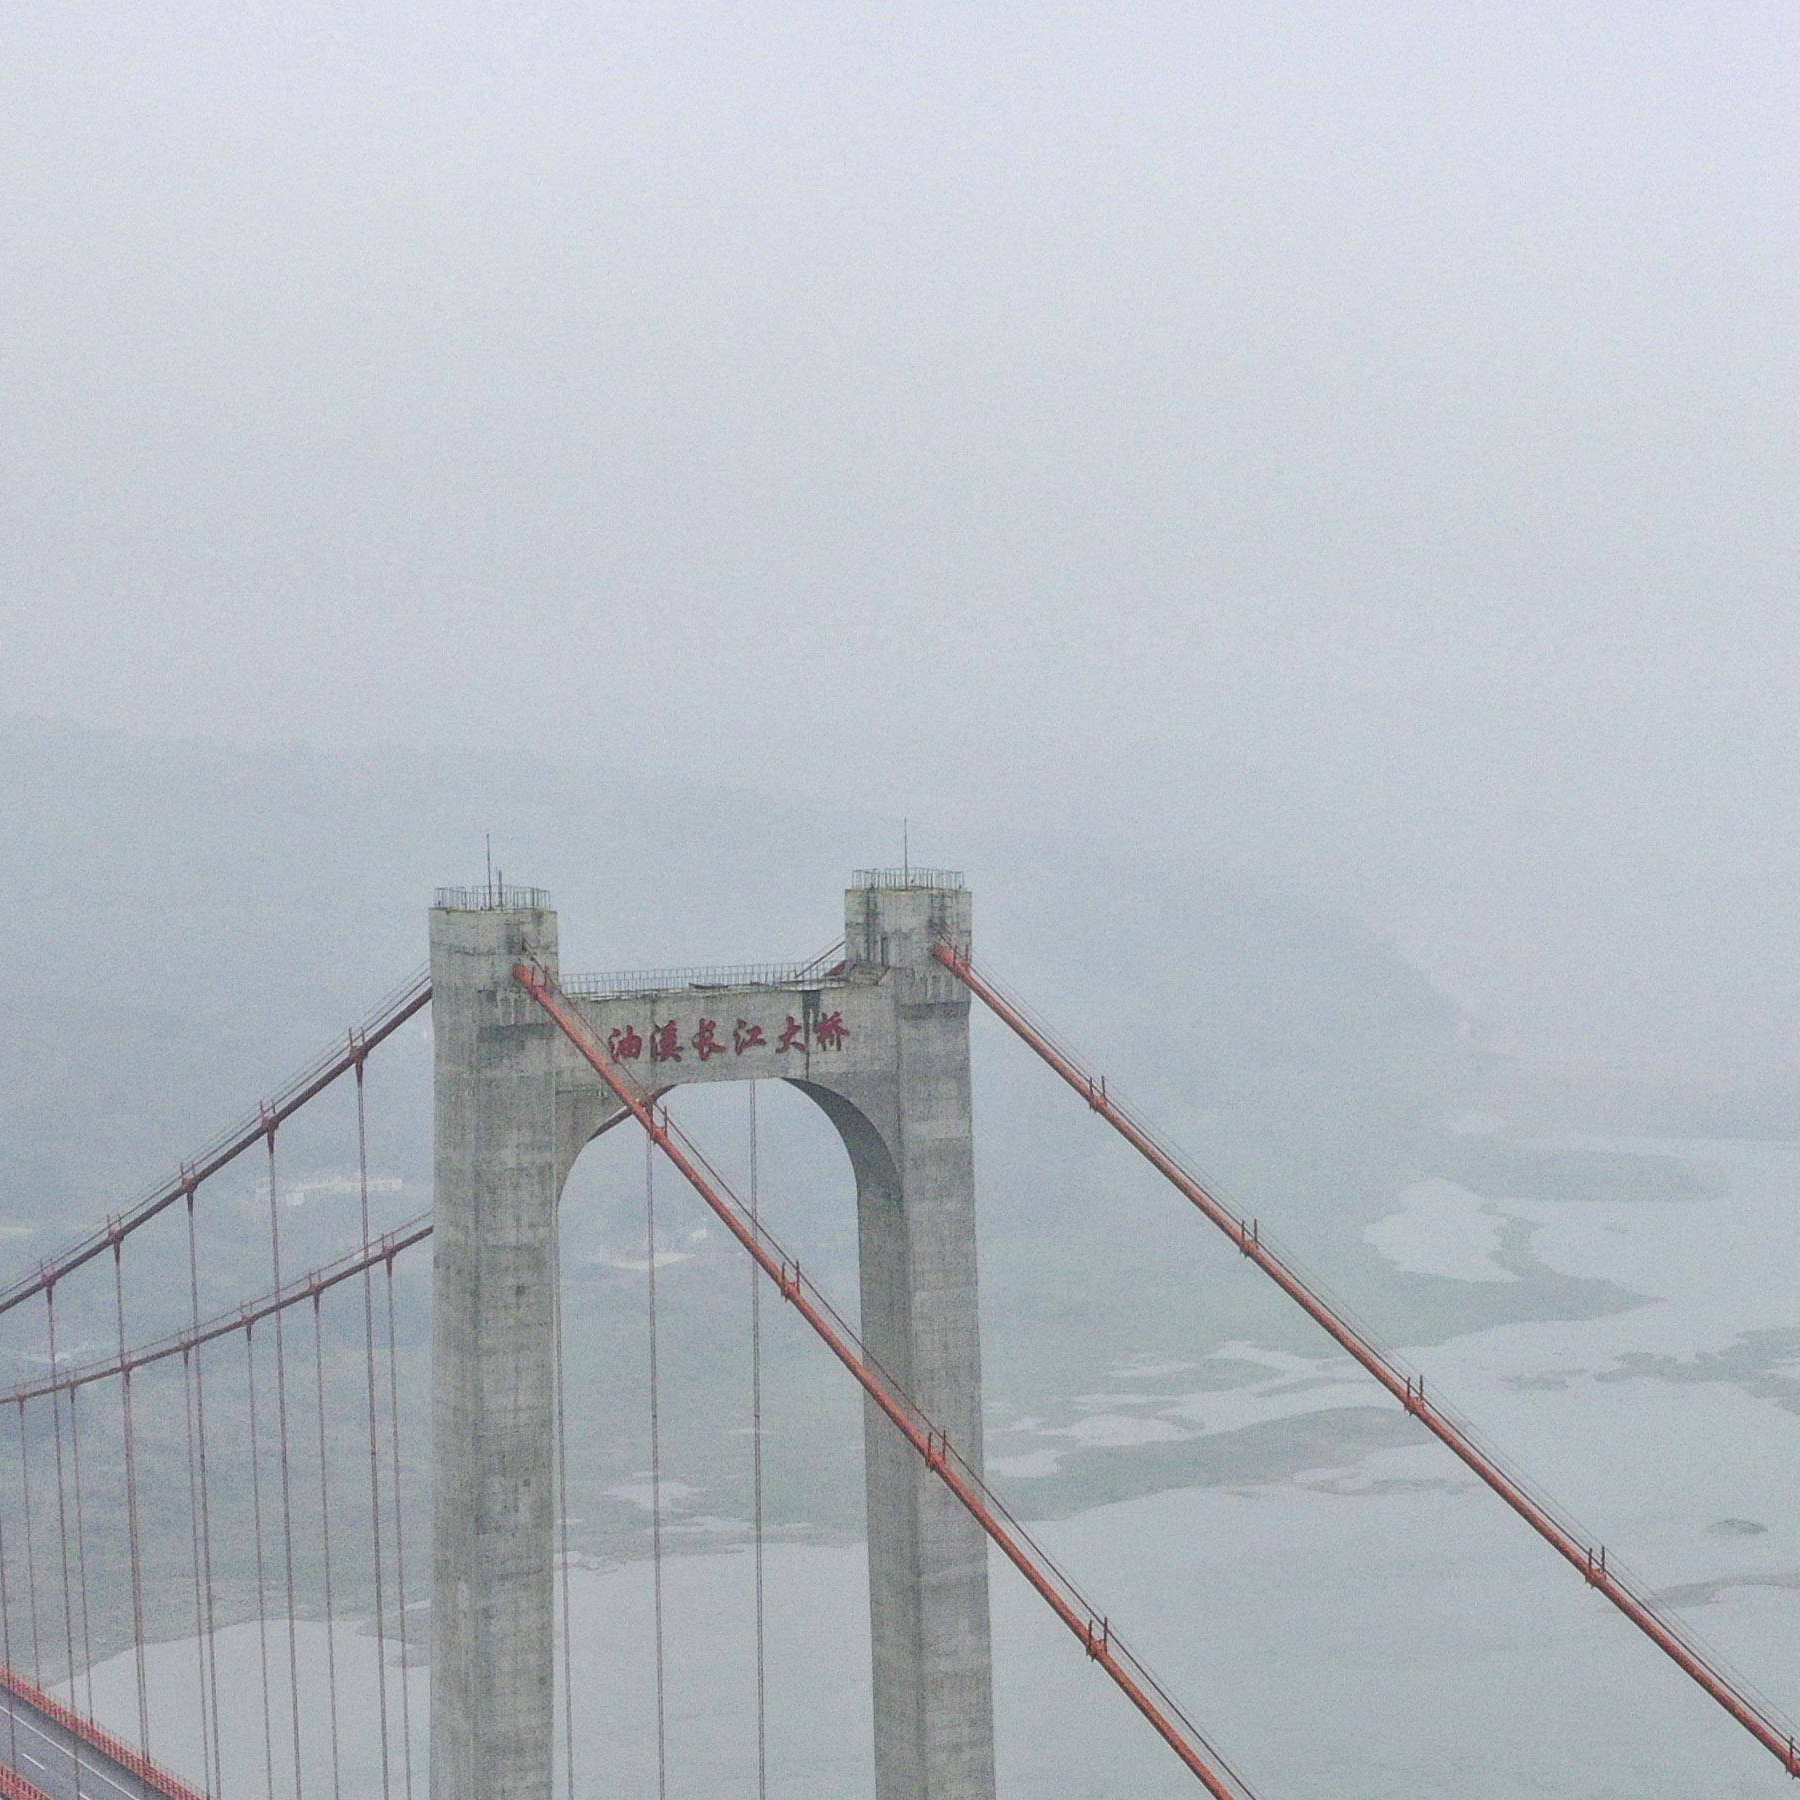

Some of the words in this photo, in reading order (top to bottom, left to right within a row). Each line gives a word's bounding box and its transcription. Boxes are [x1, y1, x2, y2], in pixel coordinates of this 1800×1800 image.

[608, 1012, 850, 1062] 油溪长江大桥
